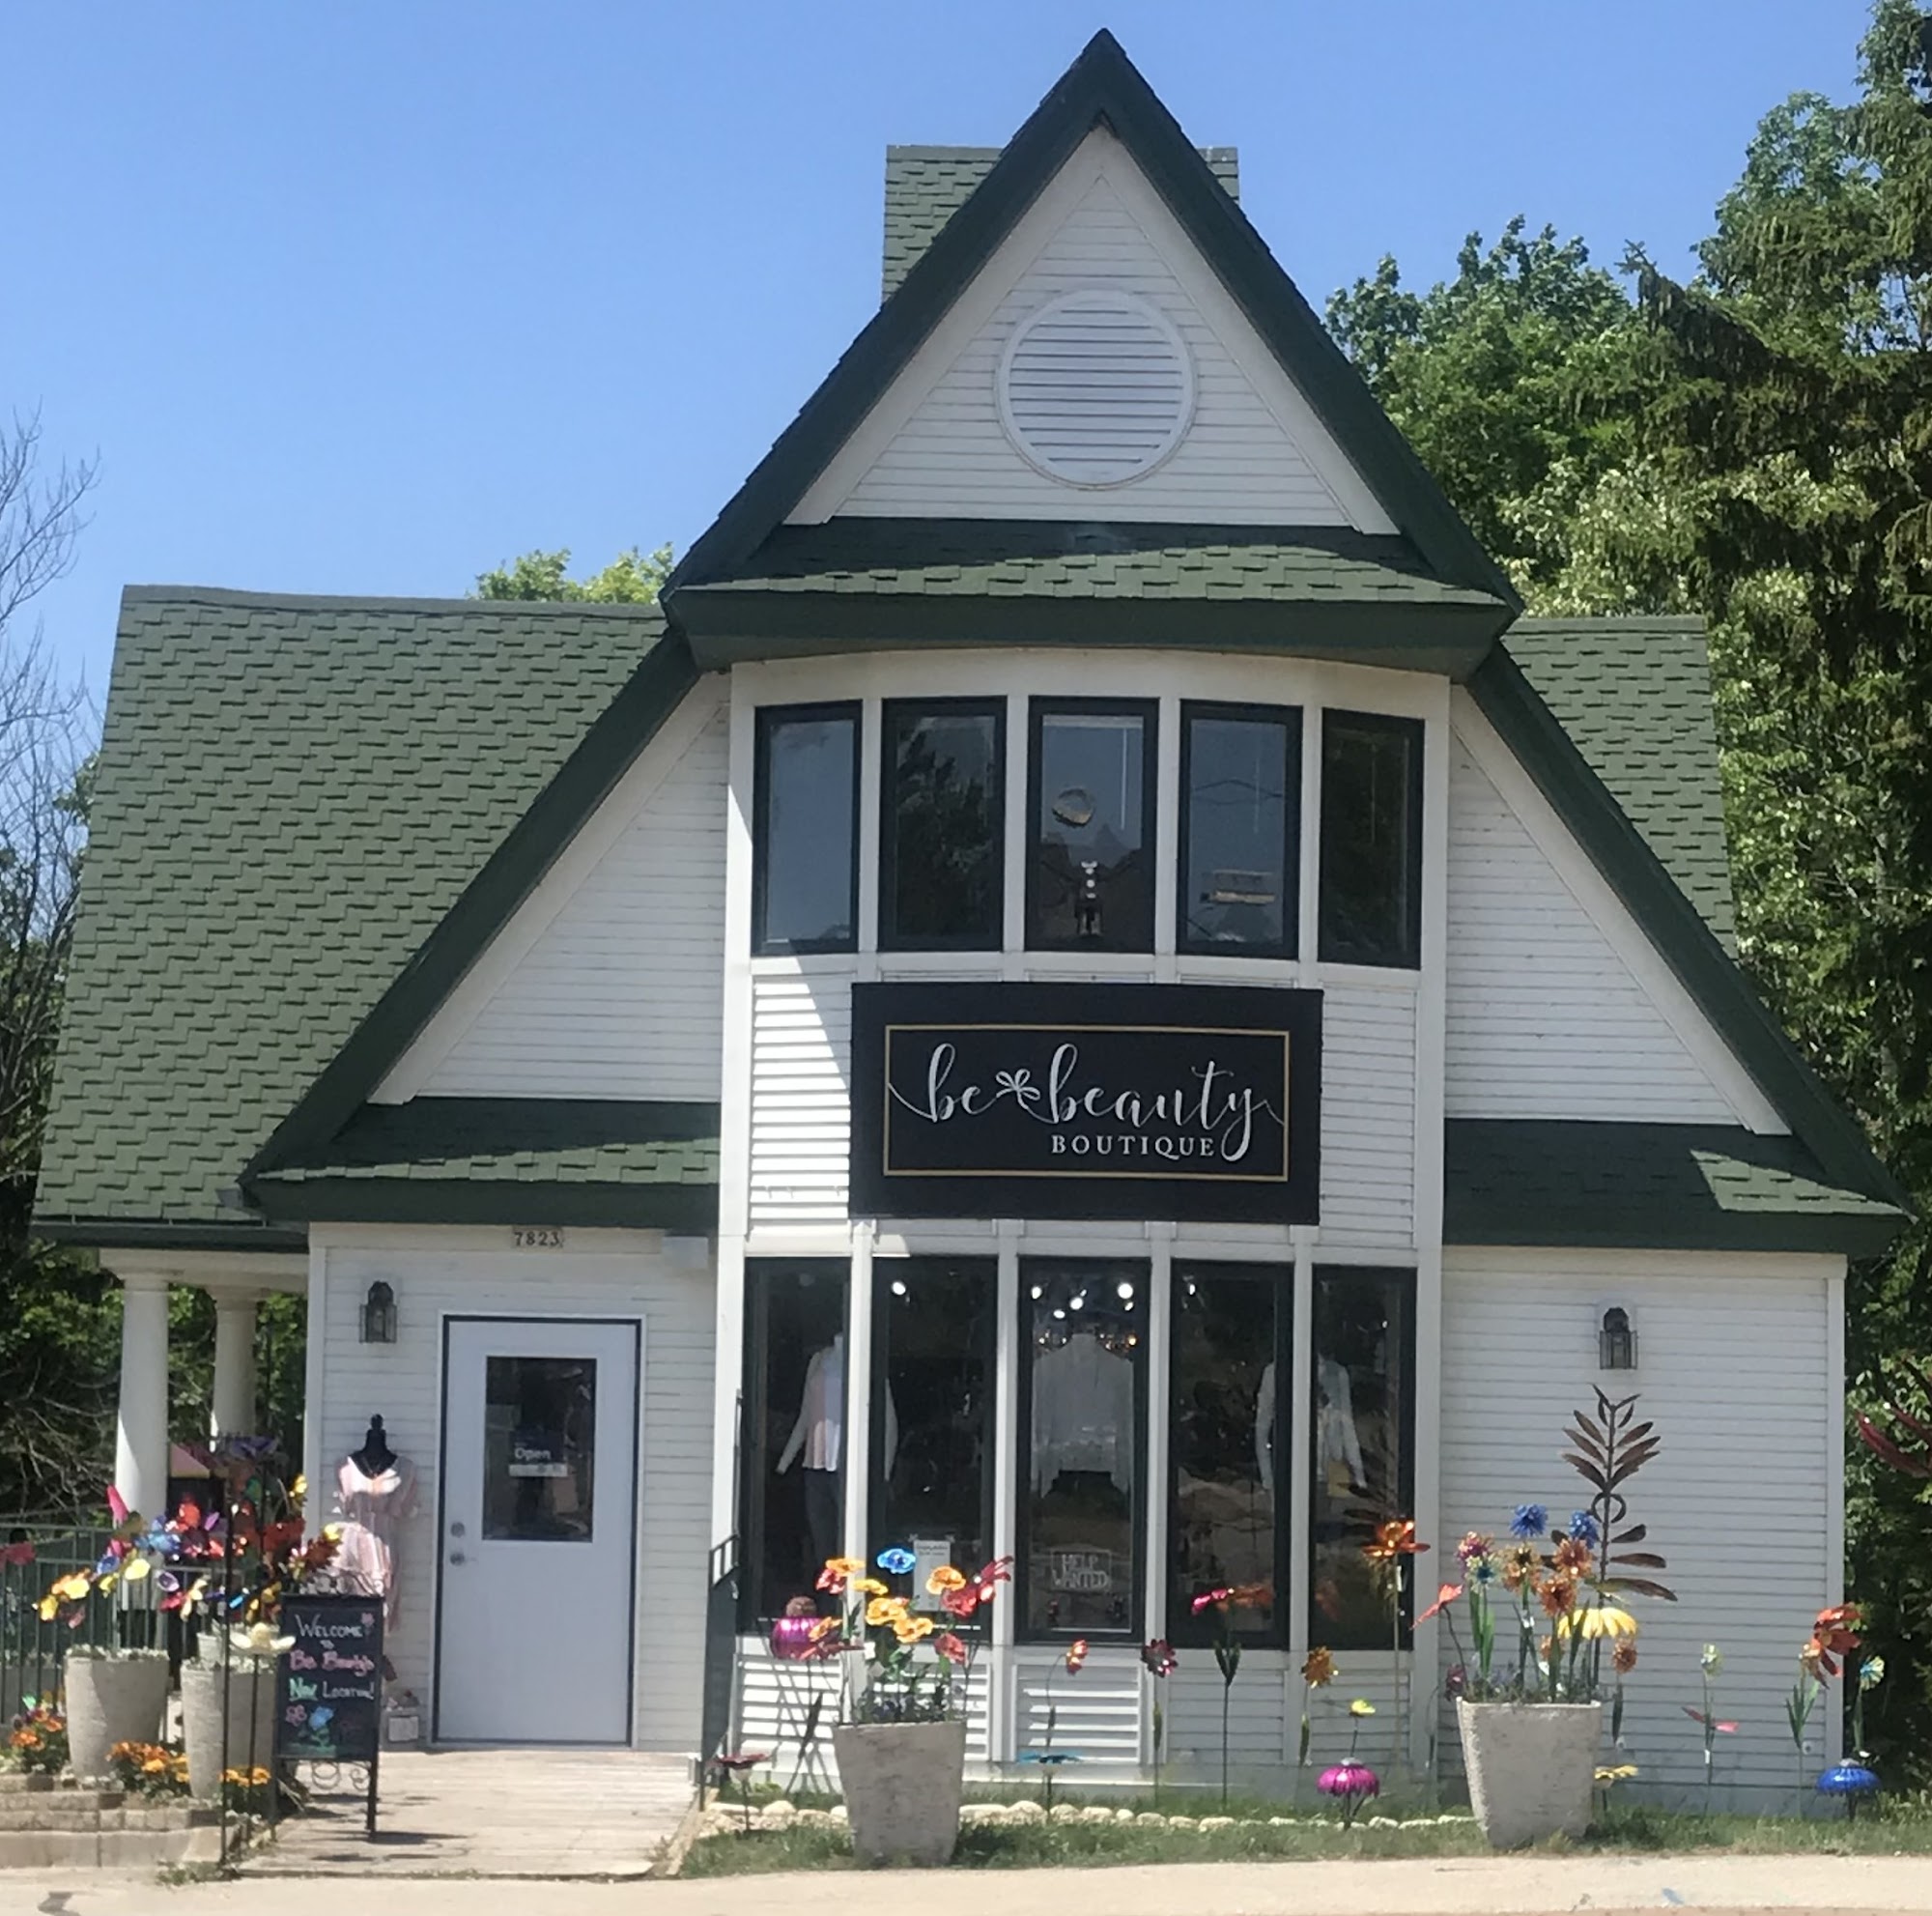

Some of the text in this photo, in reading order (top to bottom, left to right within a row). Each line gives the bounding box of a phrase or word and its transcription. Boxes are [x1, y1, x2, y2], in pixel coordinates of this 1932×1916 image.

[889, 1044, 1285, 1162] be beauty
[1051, 1135, 1215, 1160] BOUTIQUE
[514, 1231, 559, 1246] 7823
[514, 1447, 552, 1461] Open
[1062, 1554, 1098, 1571] HELP
[1051, 1569, 1110, 1589] WANTED
